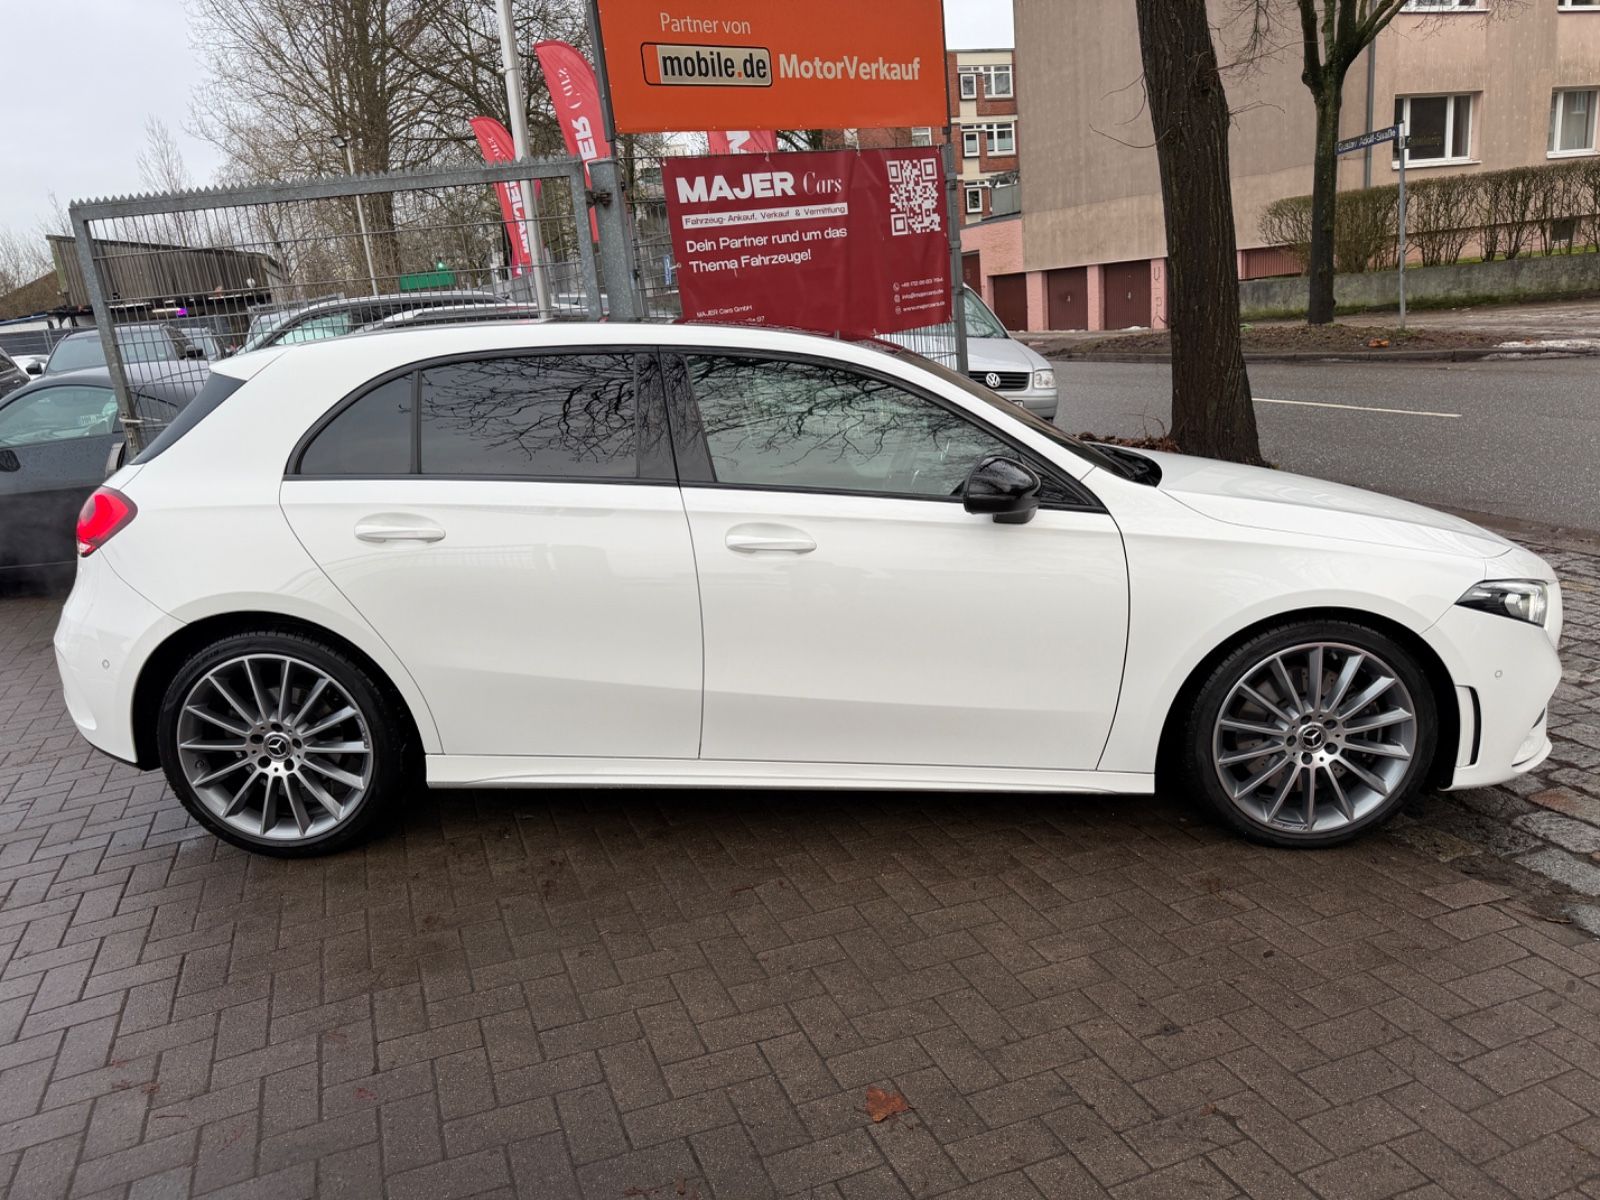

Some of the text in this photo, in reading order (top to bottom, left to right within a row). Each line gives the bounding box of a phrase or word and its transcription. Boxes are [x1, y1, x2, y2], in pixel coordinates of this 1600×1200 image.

[660, 12, 751, 35] Partner von
[662, 50, 921, 81] mobile.de MotorVerkauf
[676, 170, 843, 203] MAJER Cars
[760, 209, 790, 219] Verkauf
[794, 208, 801, 217] &
[803, 205, 846, 217] Vermittlung
[685, 226, 848, 253] Dein Partner rund um das
[689, 257, 738, 274] Thema
[740, 248, 812, 269] Fahrzeuge!
[696, 308, 718, 318] MAJER
